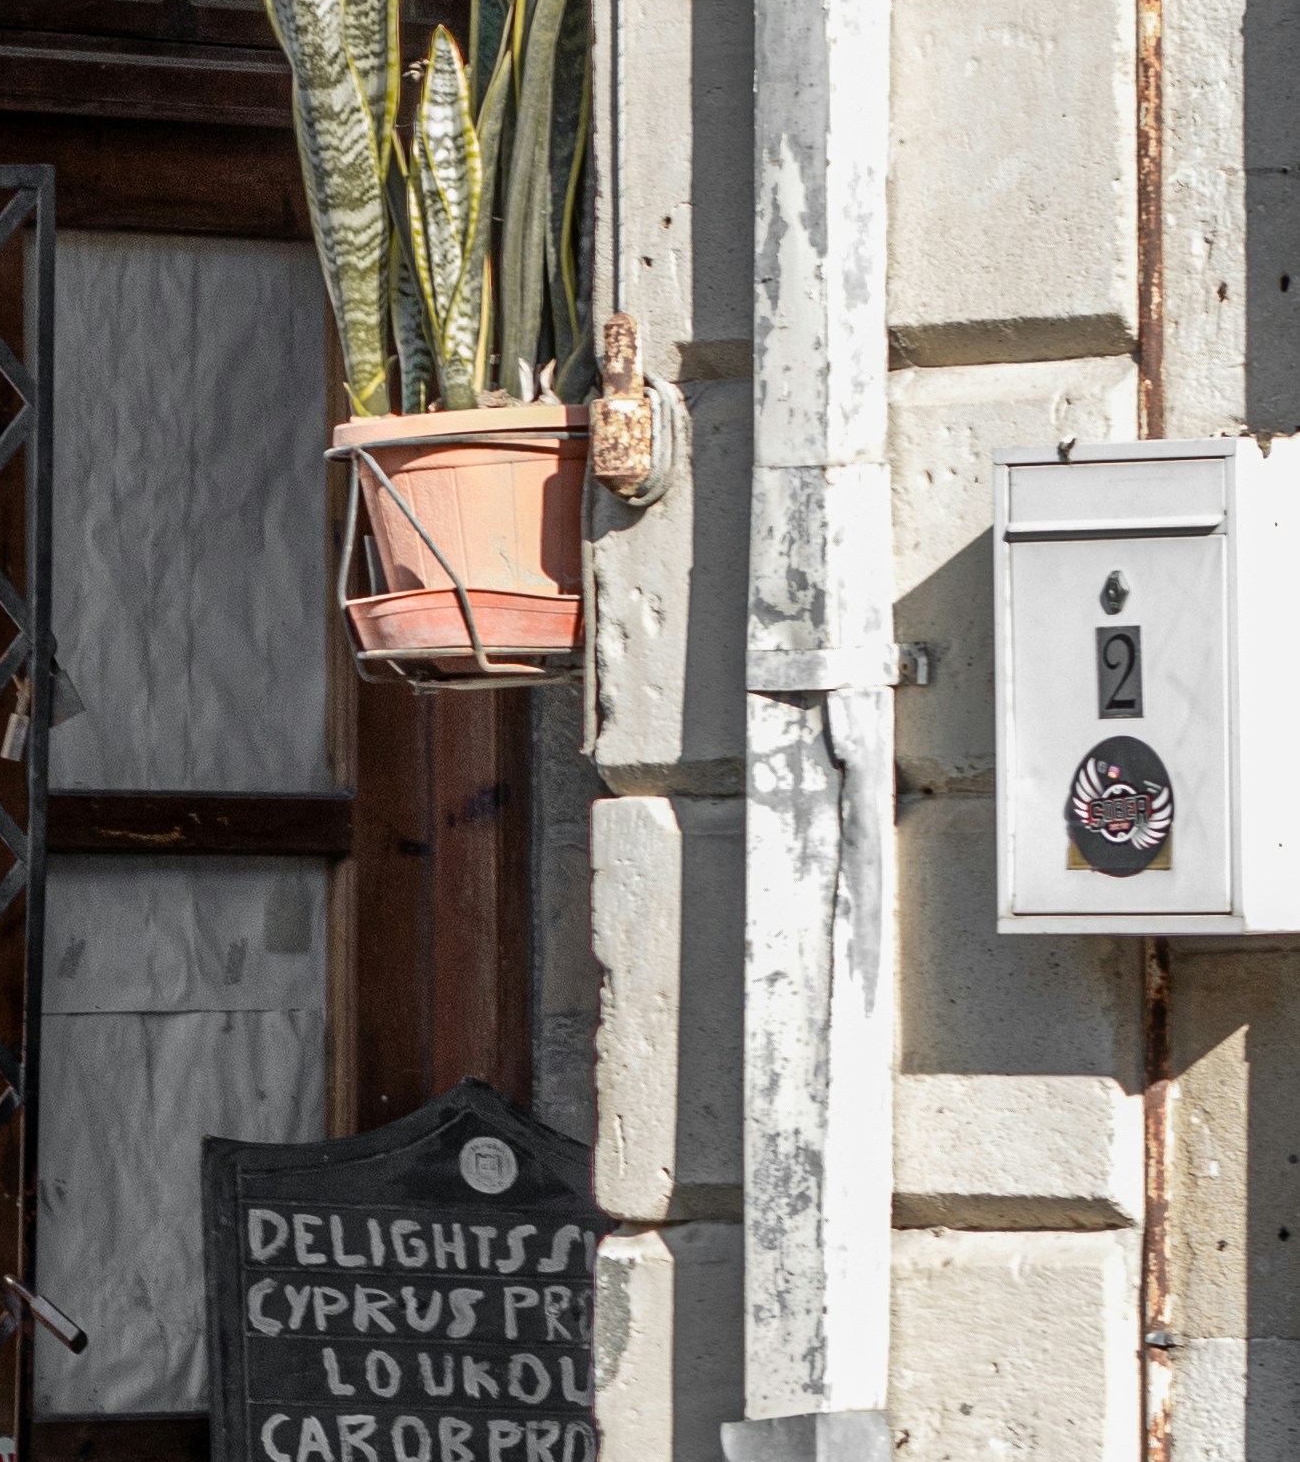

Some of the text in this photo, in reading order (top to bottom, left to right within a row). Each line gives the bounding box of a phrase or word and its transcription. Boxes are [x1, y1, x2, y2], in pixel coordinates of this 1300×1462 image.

[1102, 631, 1137, 711] 2
[247, 1208, 538, 1274] DELIGHTS
[246, 1277, 485, 1339] CYPRUS
